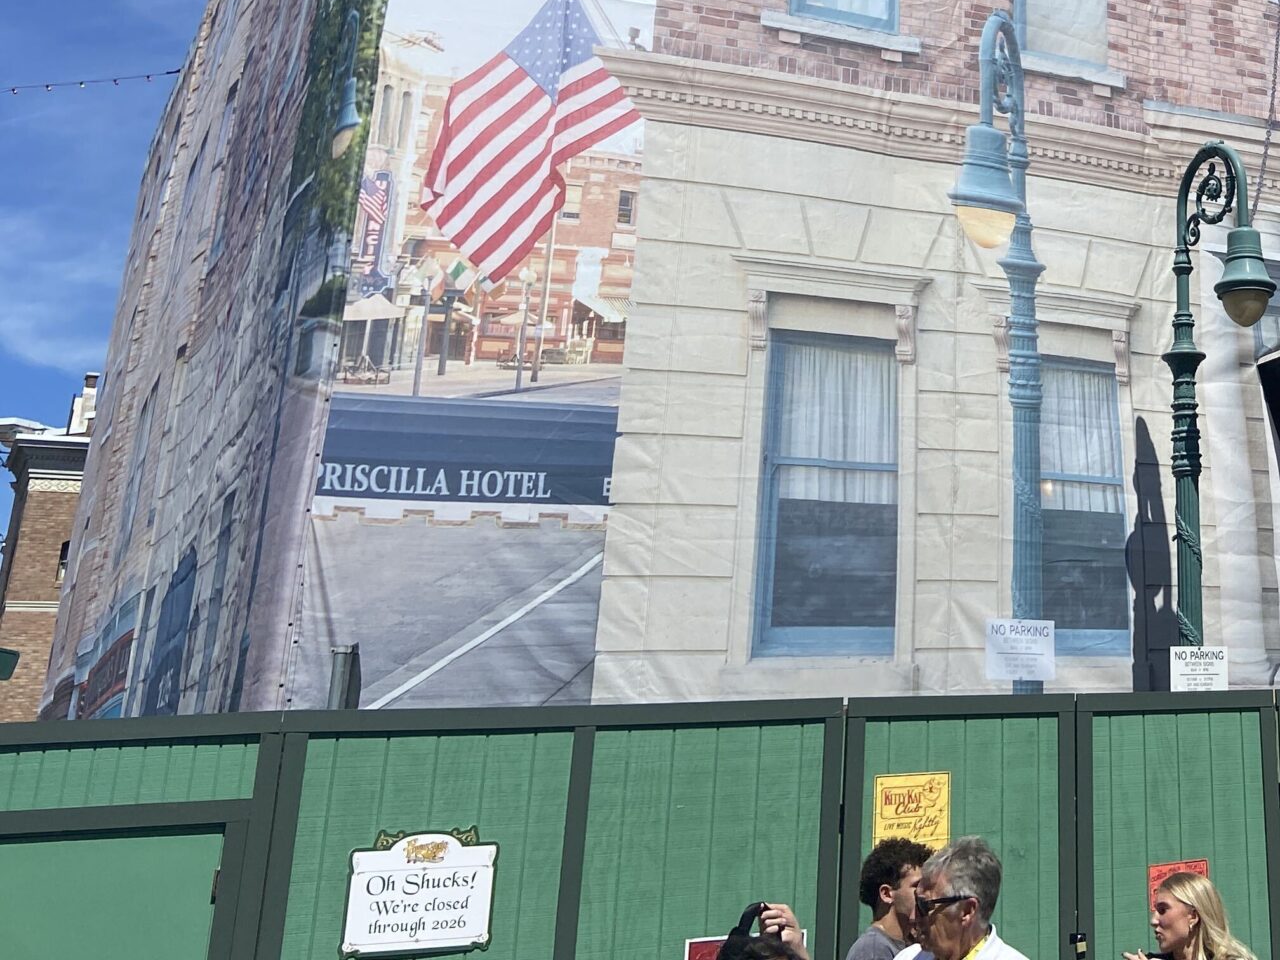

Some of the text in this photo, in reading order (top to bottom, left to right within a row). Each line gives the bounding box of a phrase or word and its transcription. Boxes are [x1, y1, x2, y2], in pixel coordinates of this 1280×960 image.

[460, 469, 551, 498] HOTEL
[991, 624, 1049, 637] NO PARKING
[1175, 650, 1224, 660] NO PARKING
[895, 801, 923, 816] Club
[884, 822, 896, 830] LIVE
[366, 870, 478, 896] Oh Shucks!
[369, 895, 471, 916] We're closed
[368, 914, 467, 938] through 2026
